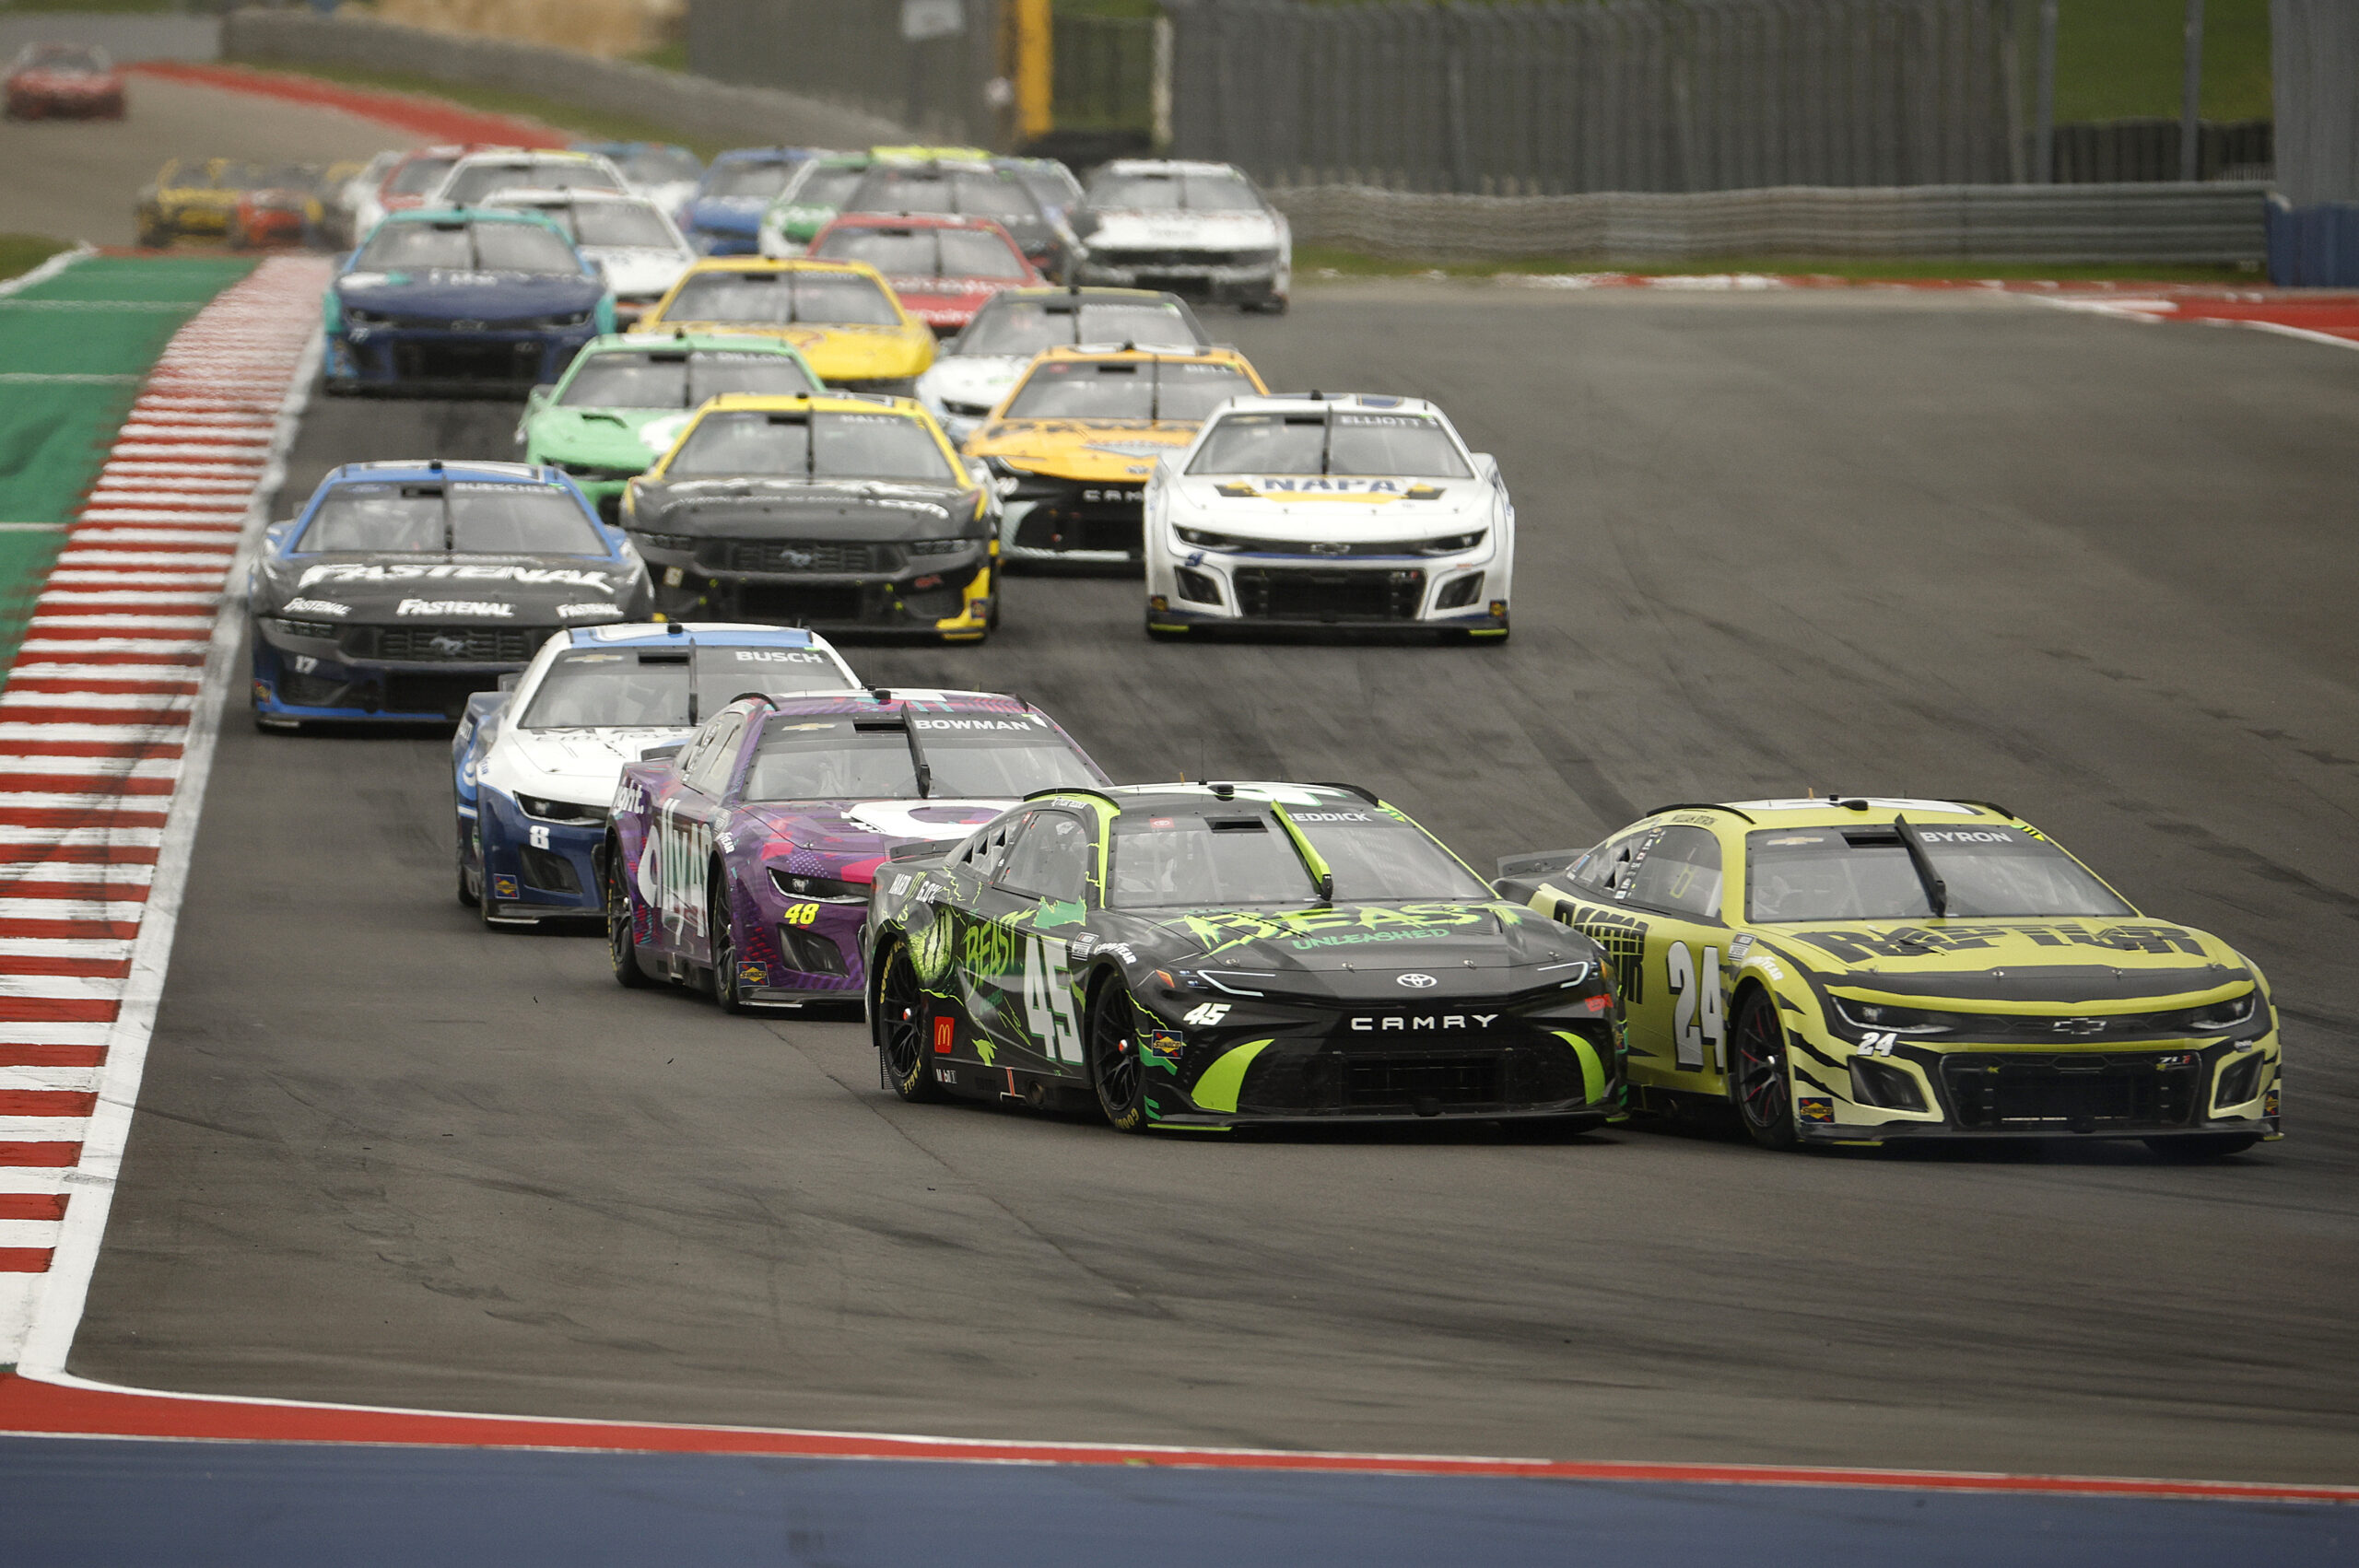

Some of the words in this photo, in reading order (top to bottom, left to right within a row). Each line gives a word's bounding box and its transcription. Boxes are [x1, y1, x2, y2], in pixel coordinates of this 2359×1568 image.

[1340, 415, 1420, 427] ELLIOTT
[1263, 477, 1401, 493] NAPA
[281, 597, 353, 617] FASTENAL
[396, 598, 517, 618] FASTENAL
[735, 650, 824, 664] BUSCH
[914, 720, 1032, 731] BOWMAN
[529, 825, 551, 850] 8
[1919, 832, 2013, 843] BYRON
[784, 903, 820, 925] 48
[1183, 903, 1530, 960] BEAST
[1291, 928, 1451, 951] UNLEASHED
[961, 907, 1037, 1002] BEAST
[1093, 942, 1137, 965] GOODYEAR
[1024, 933, 1085, 1066] 45
[1667, 941, 1725, 1074] 24
[1183, 1002, 1231, 1025] 45
[1350, 1013, 1499, 1031] CAMRY
[1154, 1039, 1181, 1049] SUNOCO
[1857, 1032, 1897, 1057] 24
